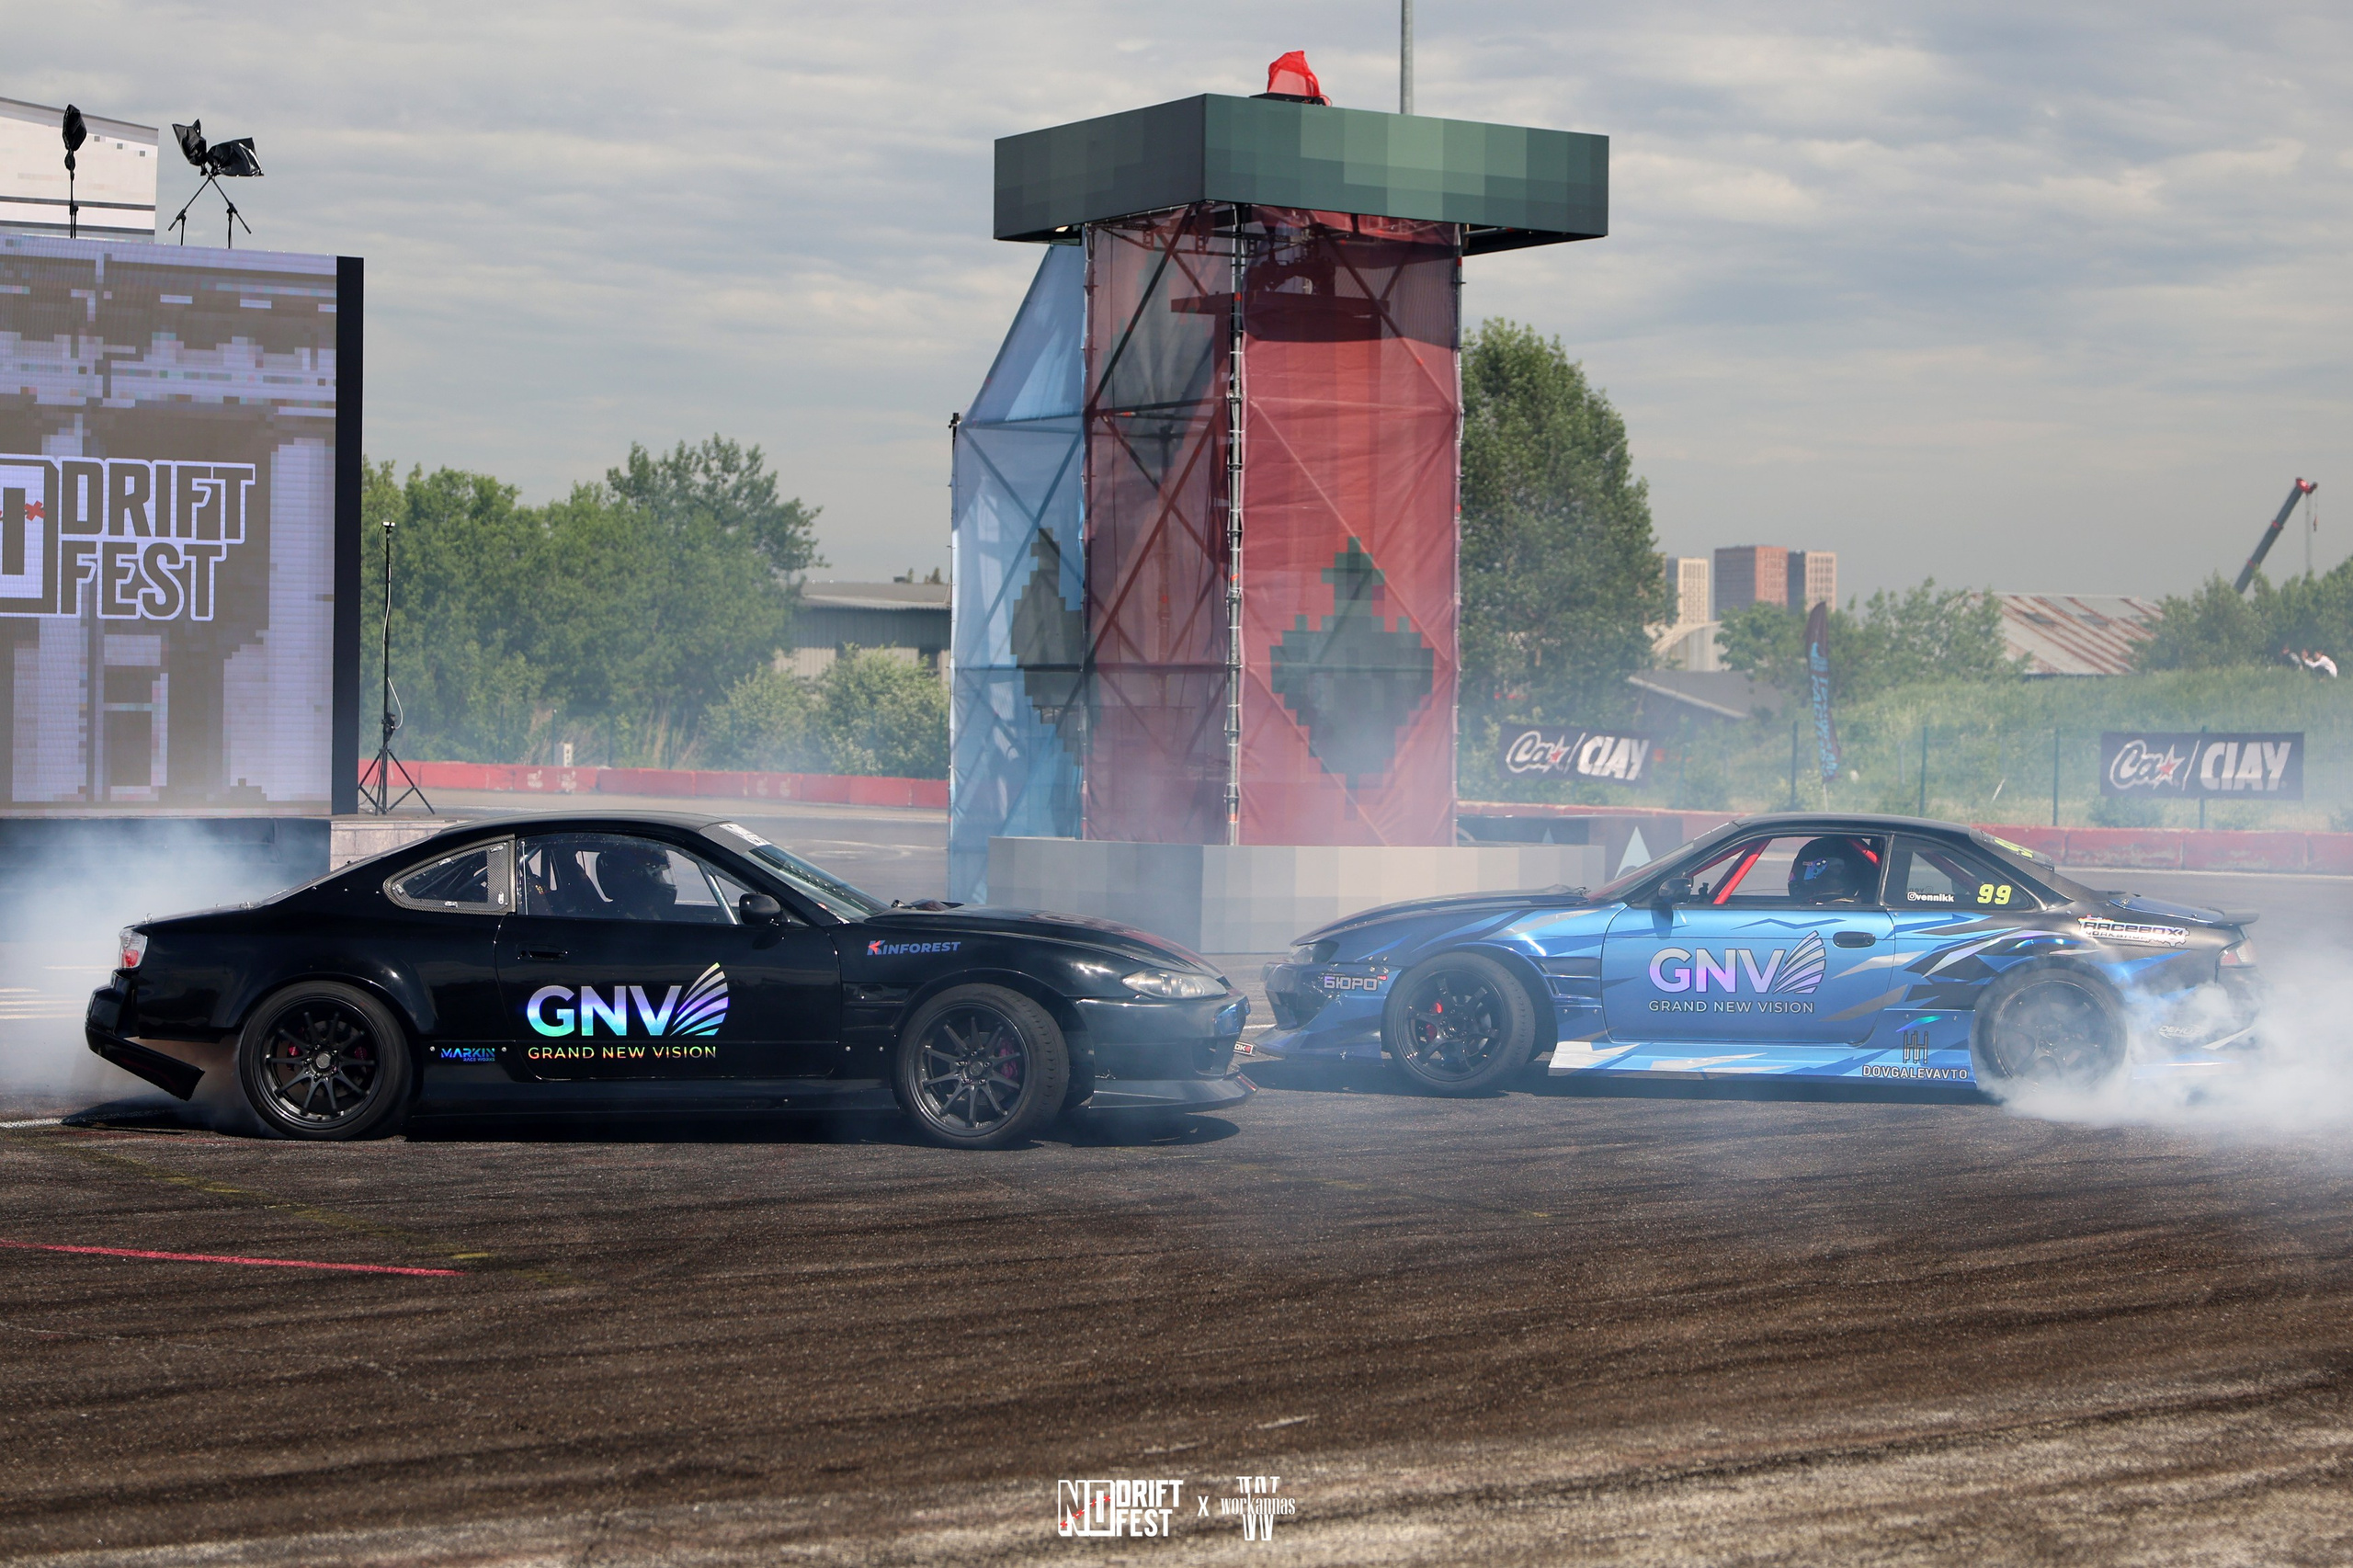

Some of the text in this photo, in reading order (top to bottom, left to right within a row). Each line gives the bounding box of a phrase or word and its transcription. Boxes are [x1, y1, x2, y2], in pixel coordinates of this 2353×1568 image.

[59, 456, 256, 544] DRIFT
[59, 538, 227, 621] FEST
[1577, 735, 1649, 780] CLAY
[2200, 742, 2291, 791] CLAY
[1977, 883, 2012, 904] 99
[867, 939, 961, 956] KINFOREST
[1649, 947, 1786, 994] GNV
[1324, 976, 1378, 991] БЮРО
[527, 984, 682, 1037] GNV
[1649, 1000, 1814, 1014] GRAND NEW VISION
[440, 1048, 495, 1058] MARKIN
[528, 1046, 717, 1060] GRAND NEW VISION
[1862, 1065, 1968, 1079] DOVGALEVAVTO
